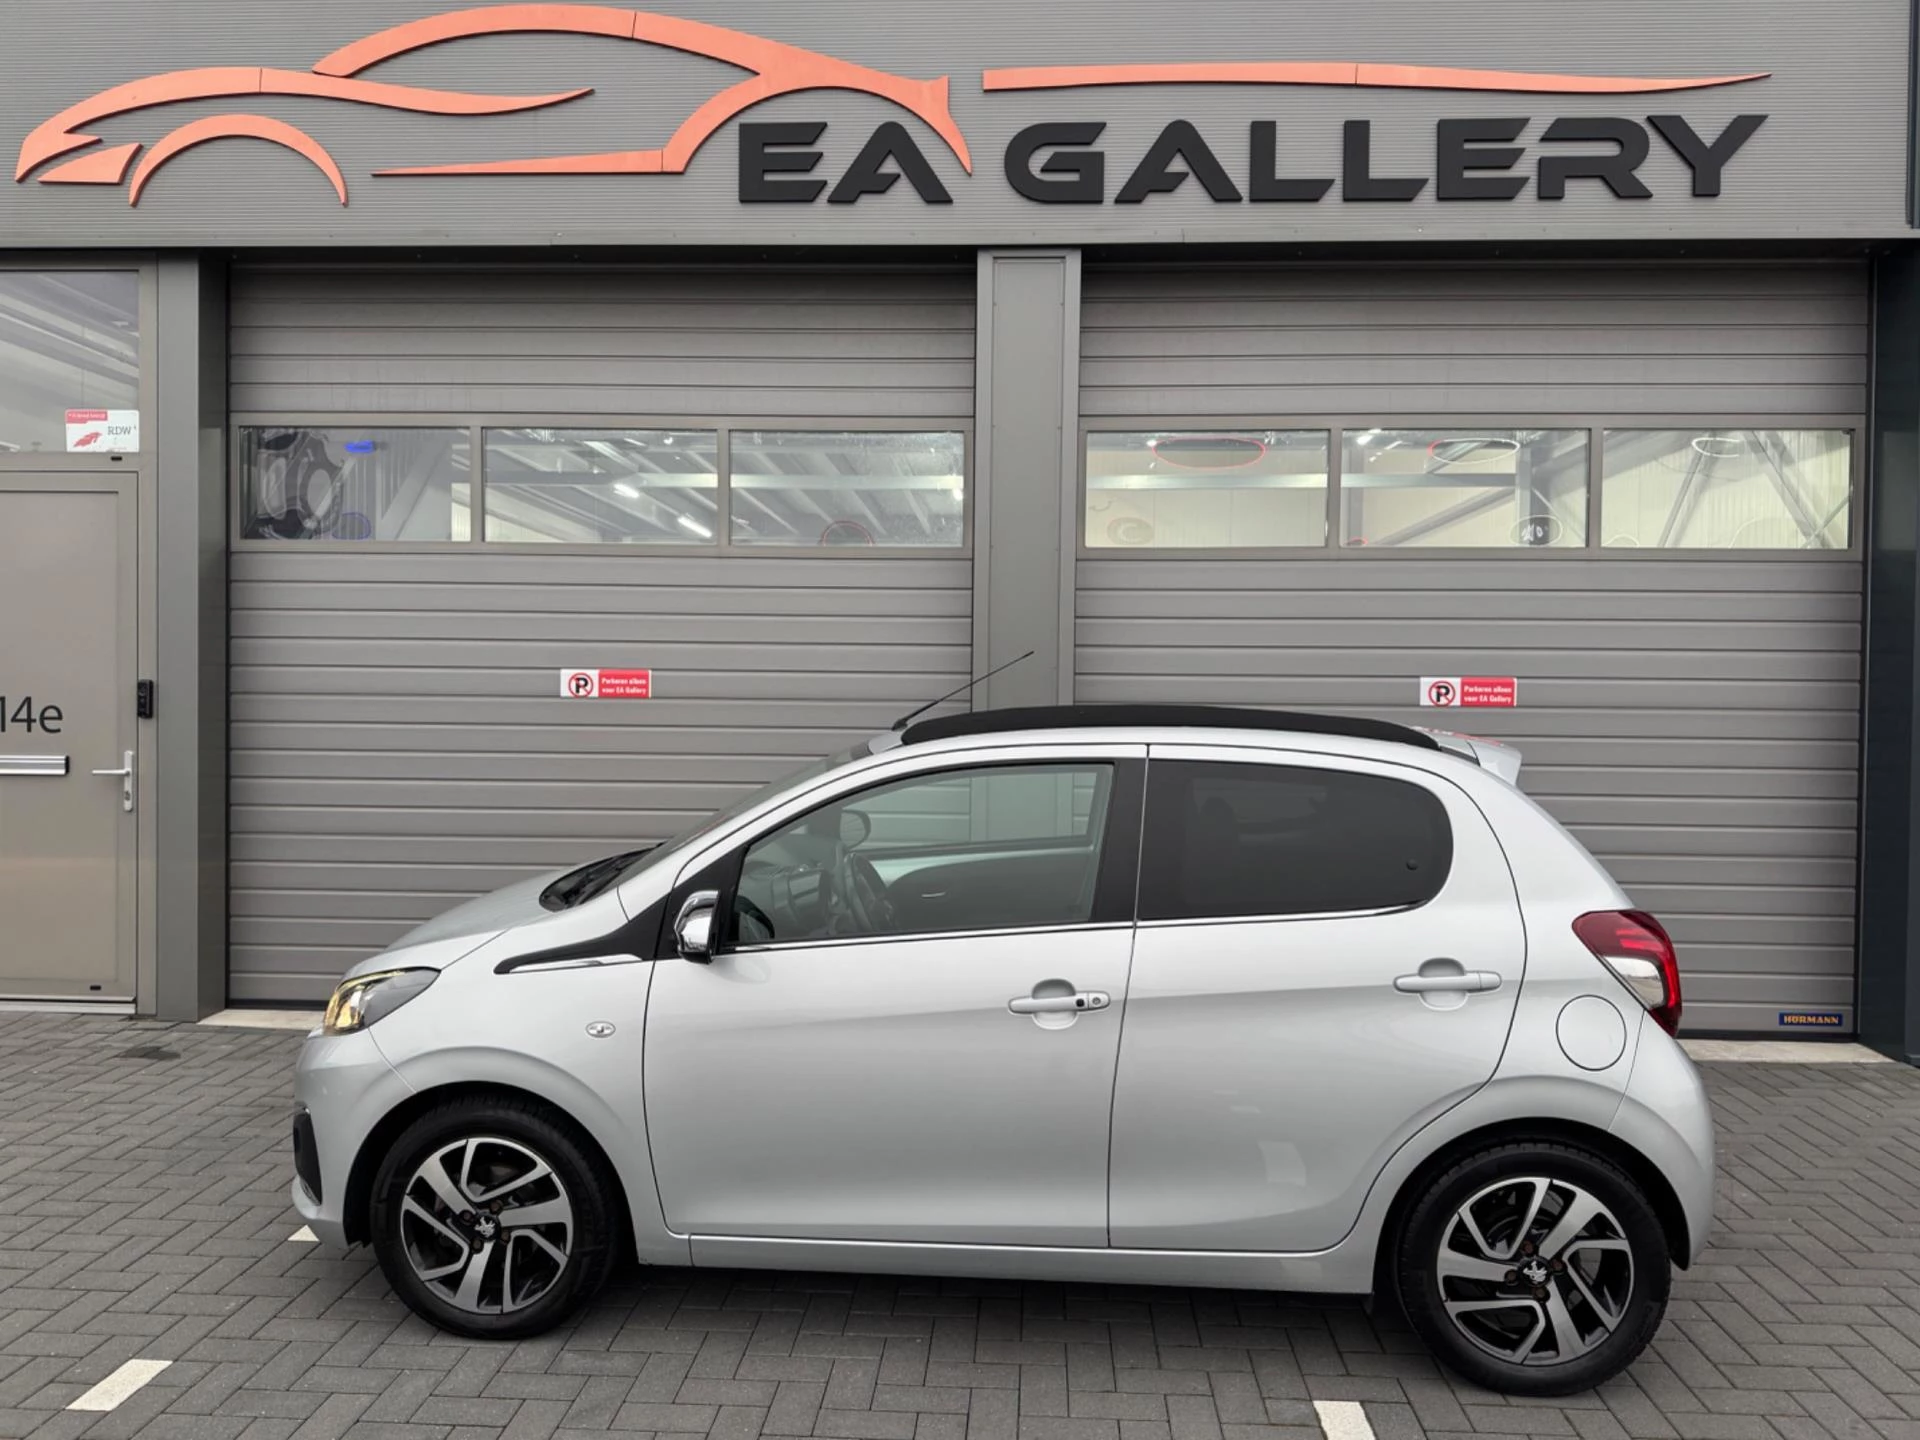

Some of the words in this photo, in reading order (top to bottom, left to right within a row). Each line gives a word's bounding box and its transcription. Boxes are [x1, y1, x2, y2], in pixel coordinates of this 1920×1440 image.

[738, 121, 954, 204] EA
[1004, 115, 1769, 204] GALLERY
[107, 425, 132, 435] RDW
[625, 687, 647, 695] Gallery
[1489, 695, 1512, 703] Gallery
[0, 696, 63, 733] 14e
